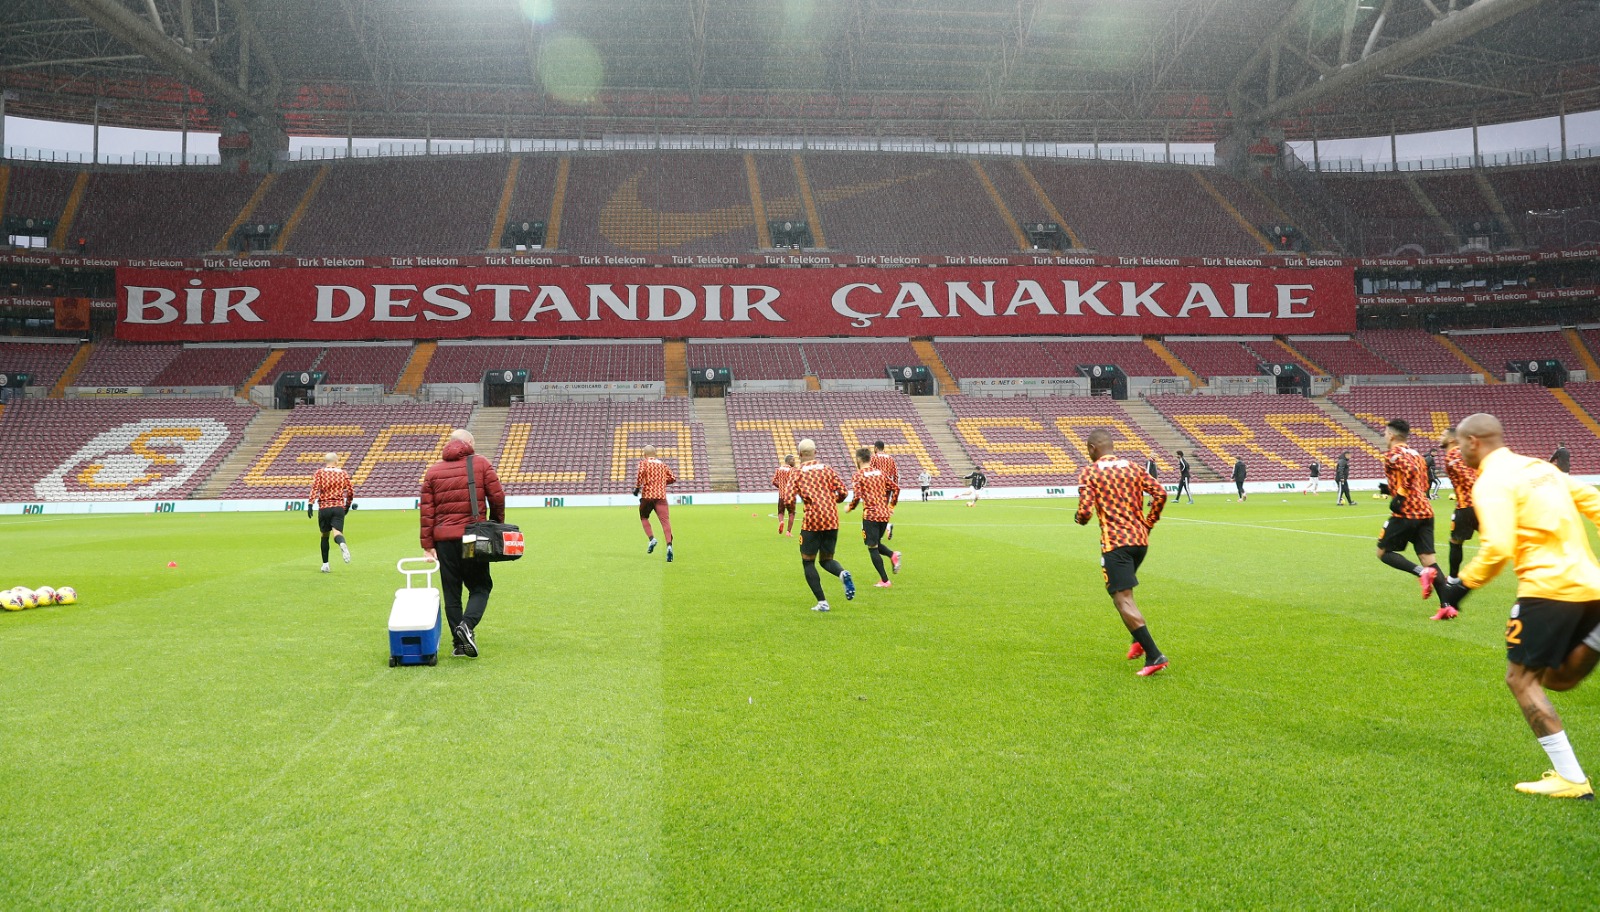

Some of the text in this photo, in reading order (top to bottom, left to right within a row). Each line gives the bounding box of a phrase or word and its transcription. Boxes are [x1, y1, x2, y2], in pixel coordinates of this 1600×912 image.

[1476, 253, 1531, 263] Türk Telekom
[1539, 249, 1598, 260] Türk Telekom
[11, 255, 50, 264] Telekom
[60, 257, 119, 267] Türk Telekom
[128, 259, 147, 267] Türk
[203, 258, 270, 267] Türk Telekom
[297, 258, 364, 266] Türk Telekom
[391, 257, 458, 266] Türk Telekom
[485, 256, 552, 265] Türk Telekom
[579, 255, 646, 264] Türk Telekom
[672, 255, 739, 264] Türk Telekom
[764, 255, 830, 264] Türk Telekom
[856, 255, 920, 264] Türk Telekom
[945, 256, 1008, 264] Türk Telekom
[1032, 256, 1095, 264] Türk Telekom
[1118, 256, 1179, 265] Türk Telekom
[1202, 257, 1262, 266] Türk Telekom
[1284, 257, 1342, 266] Türk Telekom
[1361, 258, 1377, 266] Türk
[1417, 257, 1434, 265] Türk
[1472, 292, 1528, 302] Türk Telekom
[1536, 288, 1595, 299] Türk Telekom
[1359, 296, 1376, 304] Türk
[1414, 295, 1465, 303] Türk Telekom
[312, 284, 787, 323] DESTANDIR
[830, 280, 1316, 328] ÇANAKKALE
[285, 501, 305, 511] HDI
[544, 497, 564, 507] HDI
[22, 504, 44, 514] HDI
[154, 502, 175, 513] HDI
